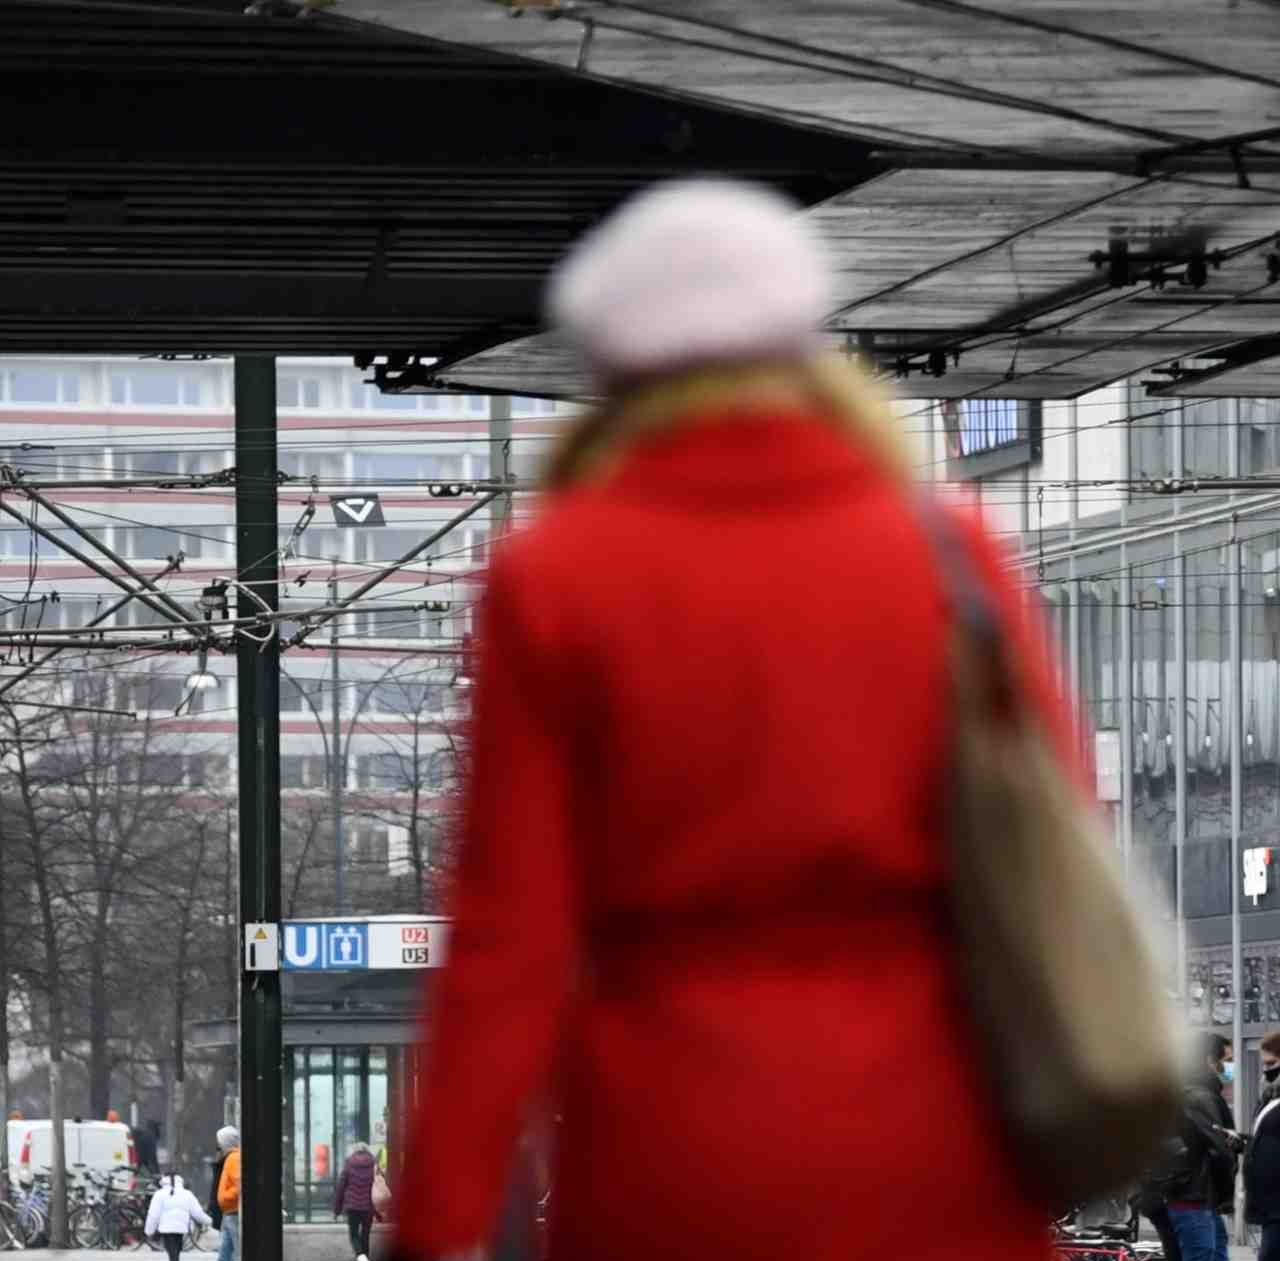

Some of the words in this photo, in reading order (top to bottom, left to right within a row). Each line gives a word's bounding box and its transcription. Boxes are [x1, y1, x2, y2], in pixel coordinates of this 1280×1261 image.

[403, 929, 427, 943] U2
[285, 926, 319, 967] U
[404, 950, 427, 963] U5
